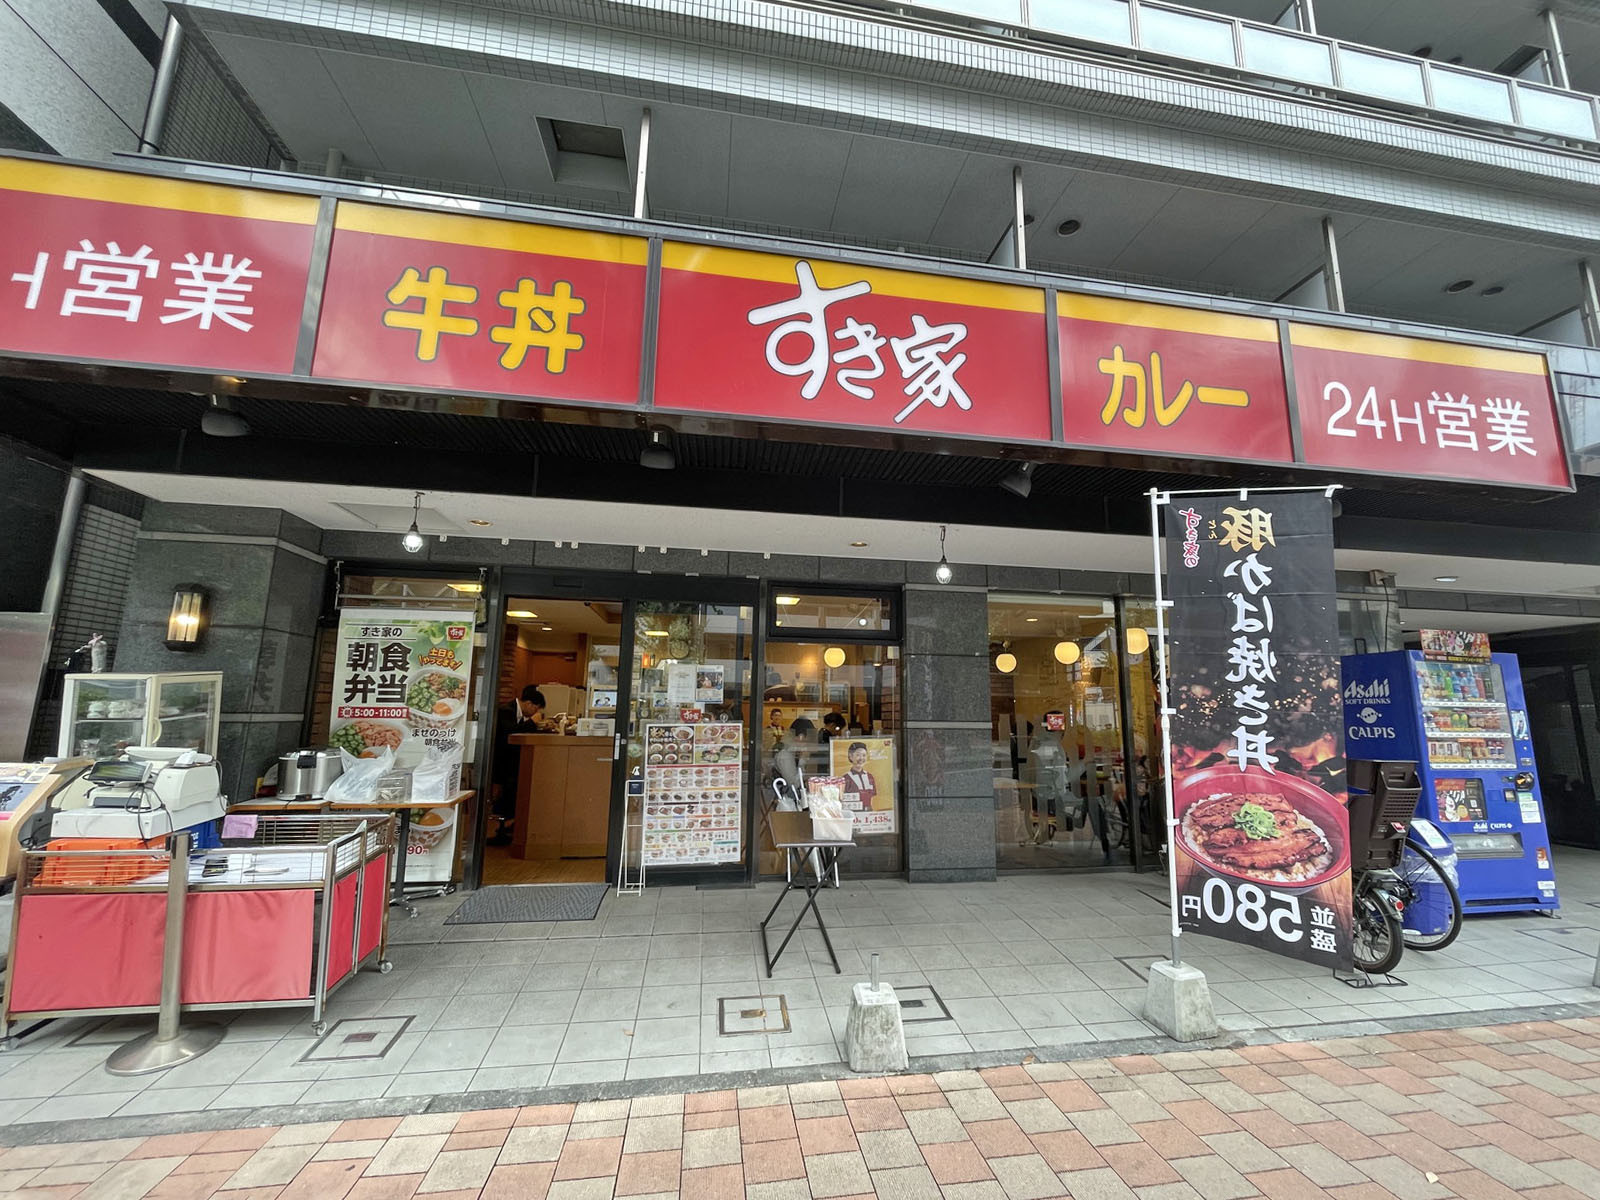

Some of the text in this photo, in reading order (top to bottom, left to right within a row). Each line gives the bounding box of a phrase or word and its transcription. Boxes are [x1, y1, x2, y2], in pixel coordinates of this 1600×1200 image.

[382, 266, 586, 374] 牛丼
[747, 260, 972, 423] すき家
[1098, 344, 1250, 428] カレー
[1323, 380, 1538, 457] 24H営業
[361, 626, 403, 638] すき家の
[346, 641, 412, 672] 朝食
[429, 647, 455, 659] 土日も
[343, 673, 409, 704] 弁当
[1344, 678, 1390, 698] Asahi
[1348, 726, 1396, 740] CALPIS
